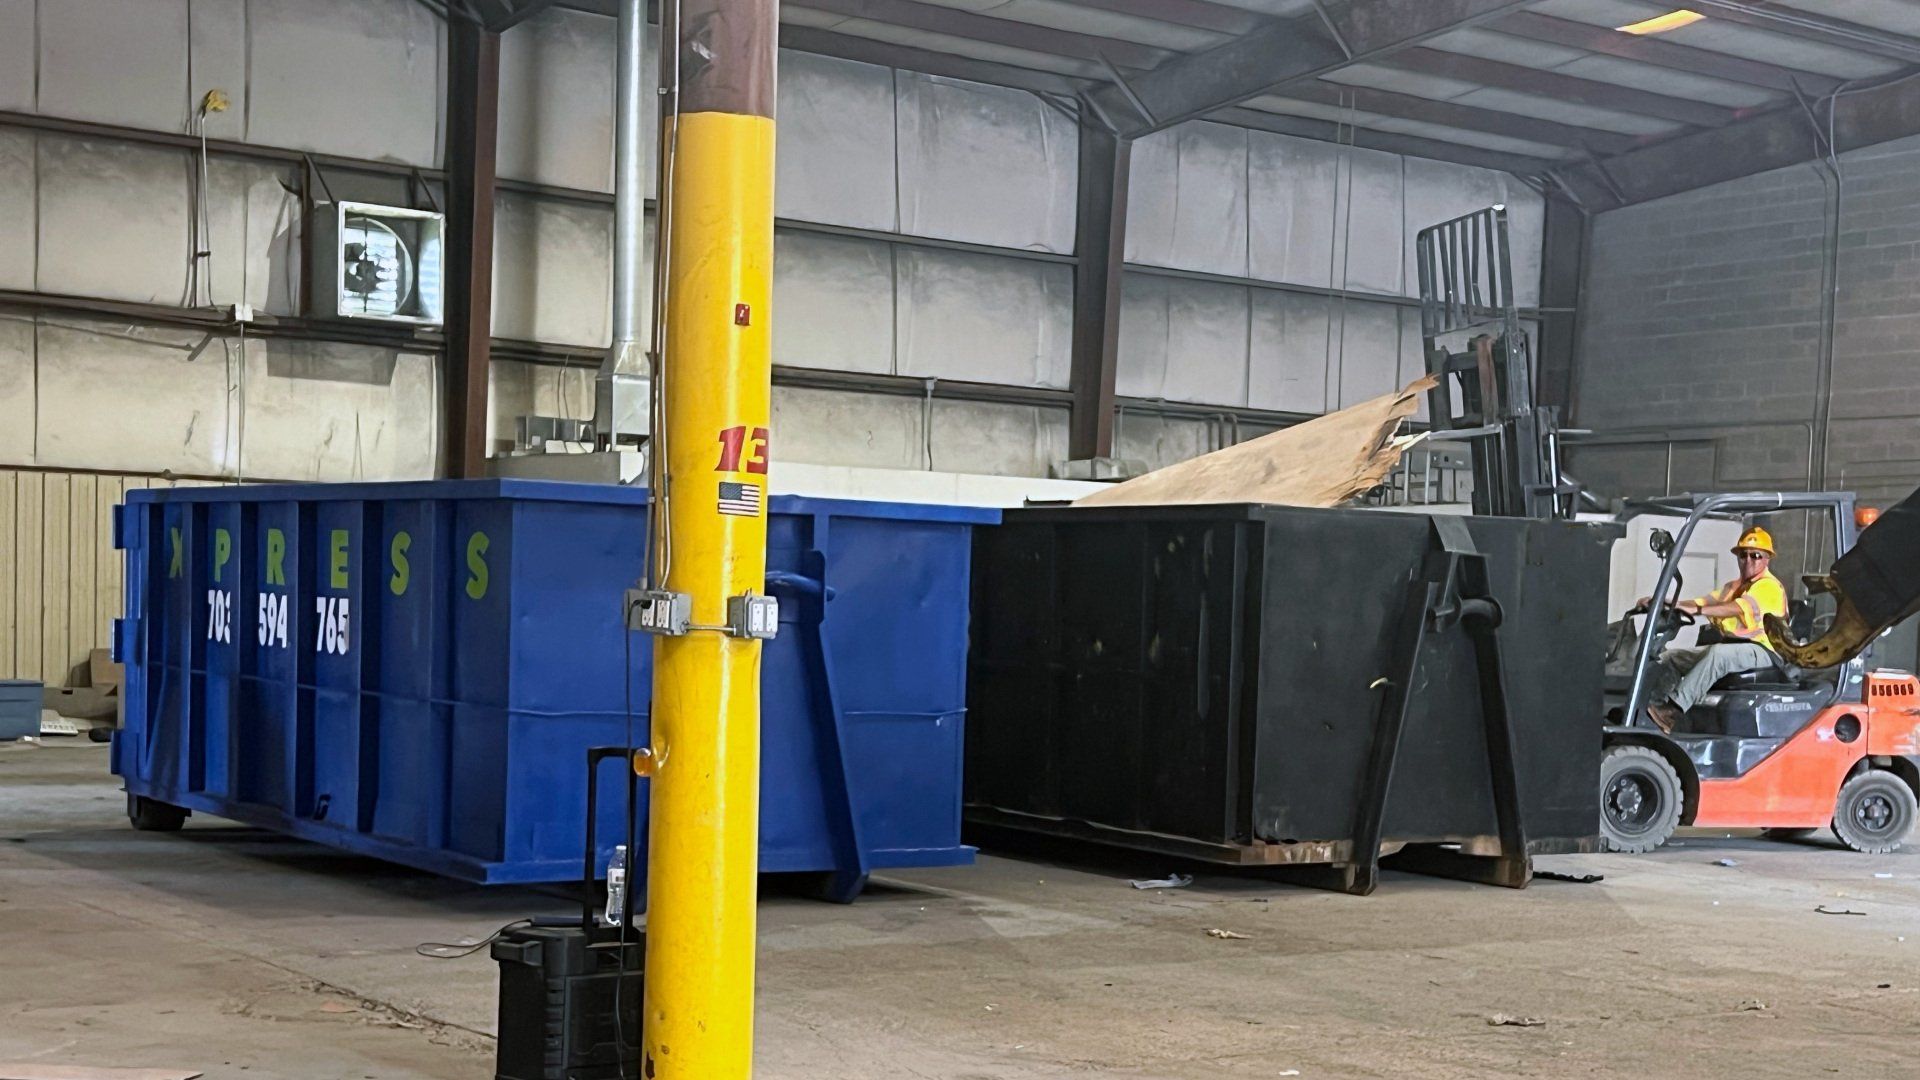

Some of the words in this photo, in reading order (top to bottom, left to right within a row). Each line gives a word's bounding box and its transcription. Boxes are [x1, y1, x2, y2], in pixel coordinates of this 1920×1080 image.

[714, 426, 769, 474] 13
[258, 592, 288, 648] 594
[316, 596, 350, 655] 765
